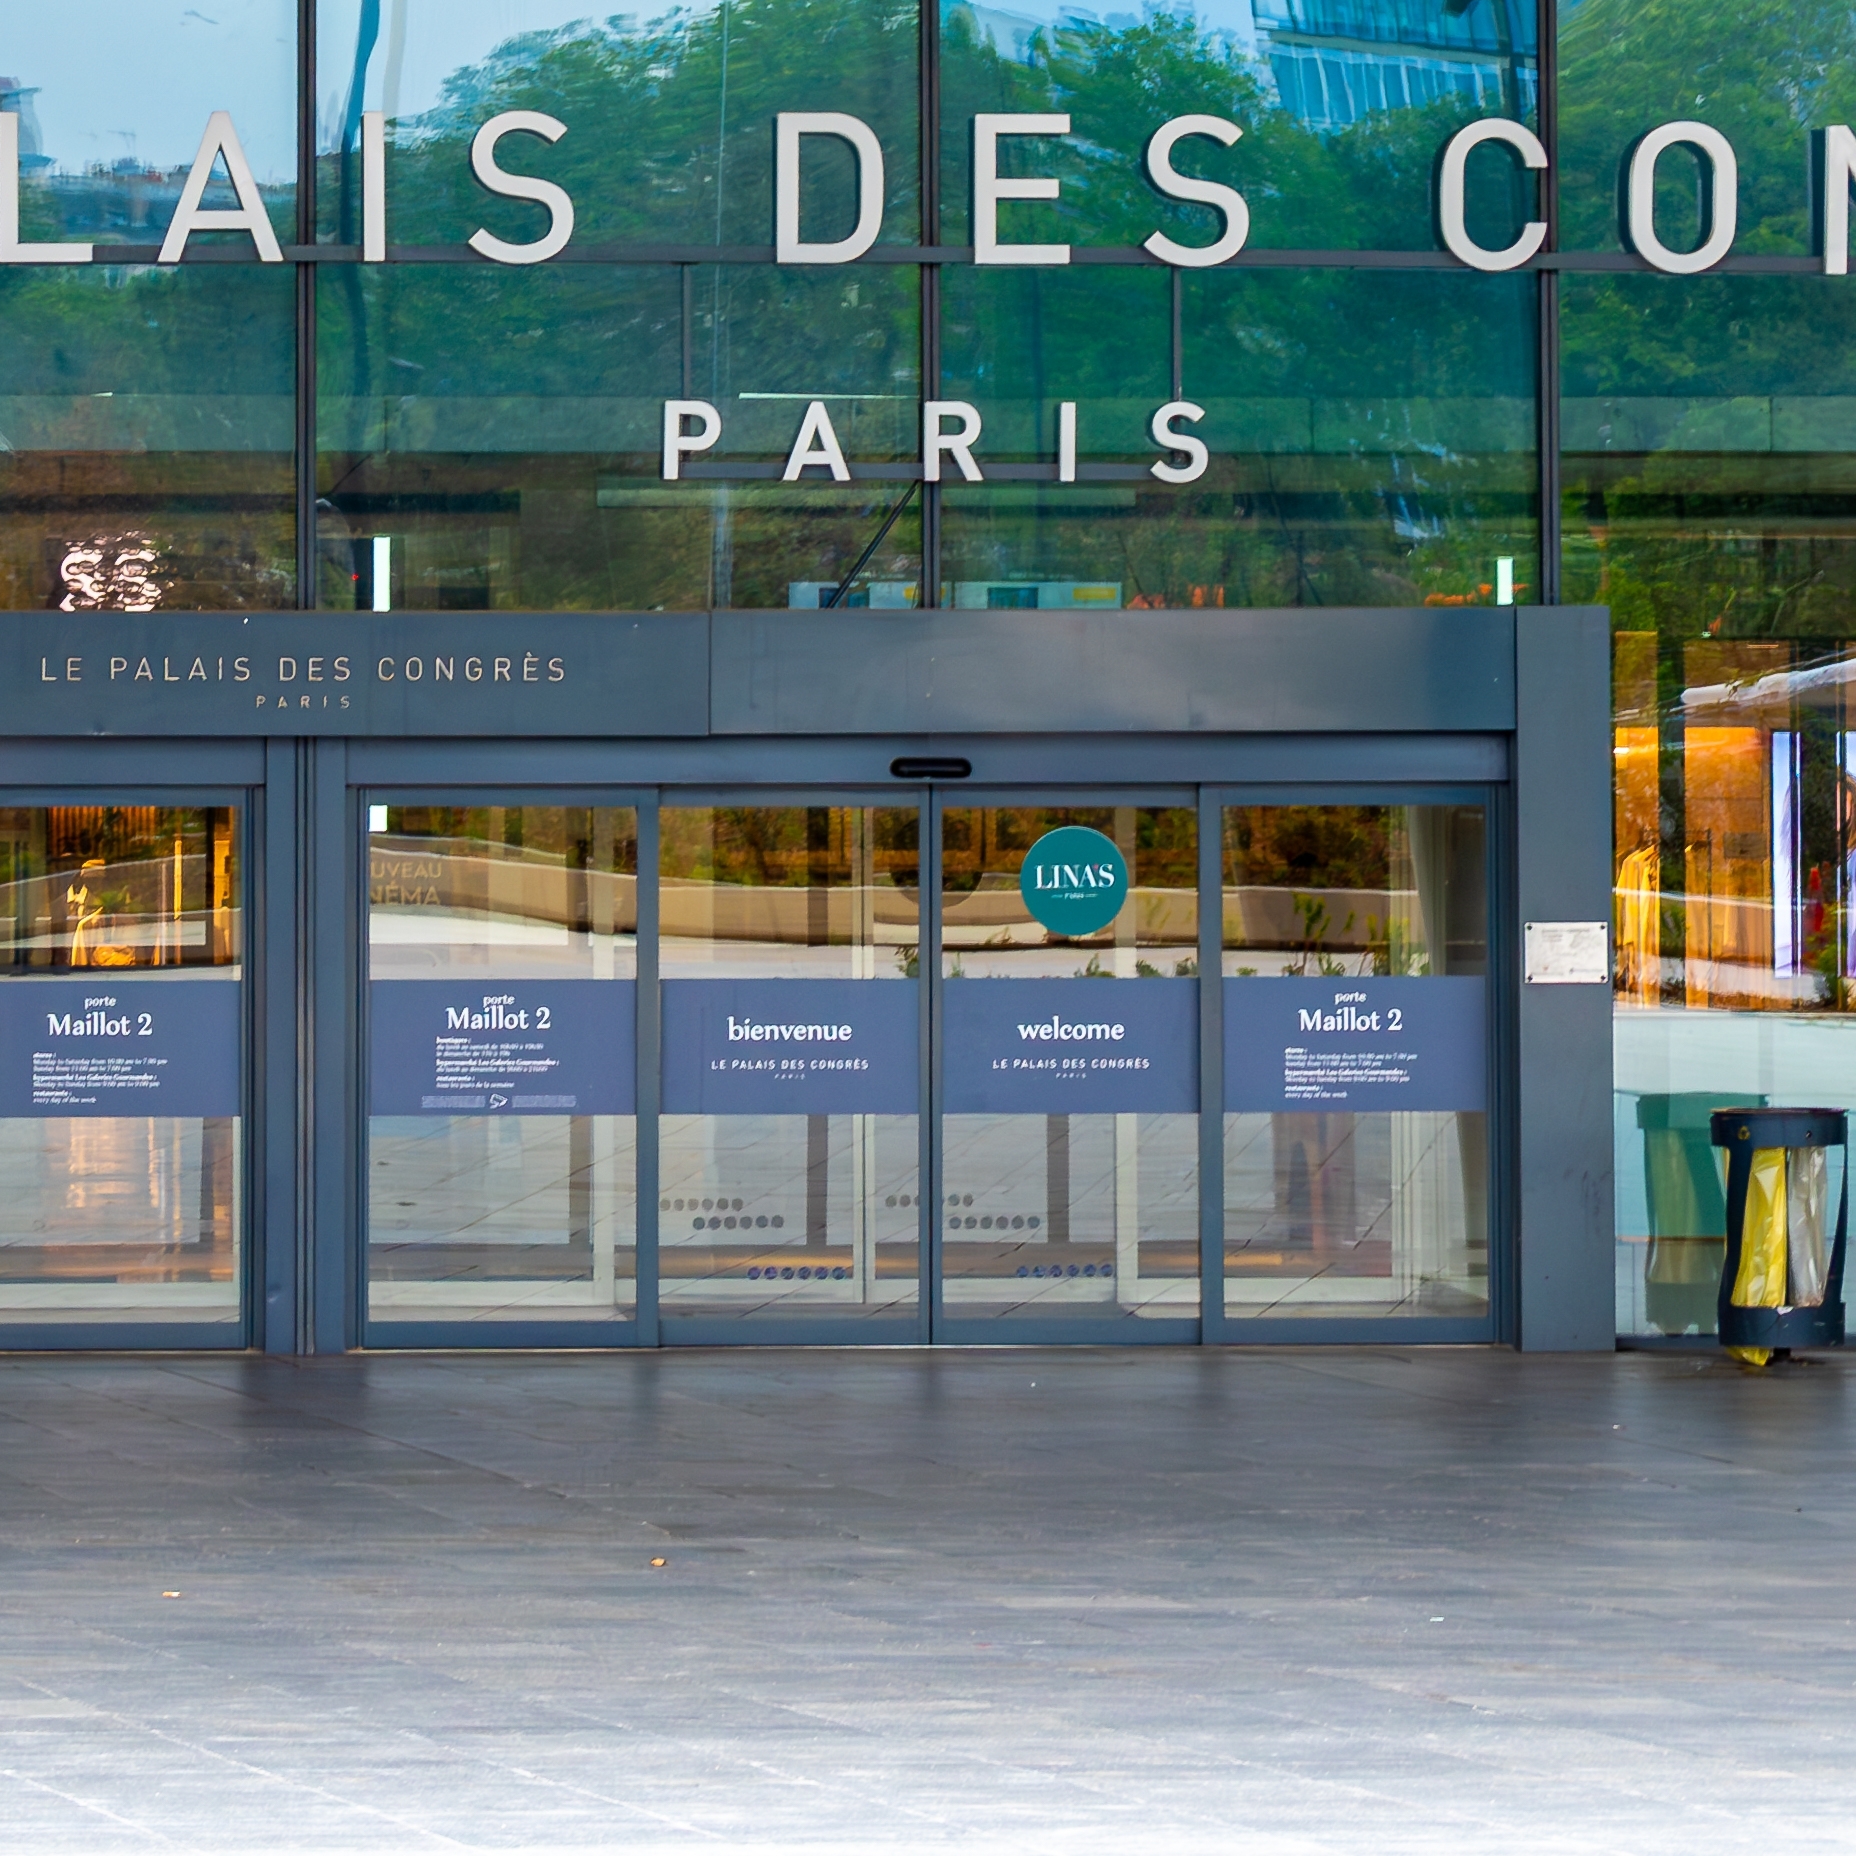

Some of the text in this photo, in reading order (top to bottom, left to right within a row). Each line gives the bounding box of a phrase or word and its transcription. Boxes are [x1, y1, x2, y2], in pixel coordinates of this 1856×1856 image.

[774, 113, 1253, 270] DES
[662, 400, 1210, 485] PARIS
[41, 650, 567, 682] LE PALAIS DES CONGRÈS
[255, 695, 352, 710] PARIS
[370, 861, 442, 878] UVEAU
[370, 880, 442, 905] NÉMA
[84, 995, 117, 1010] porte
[483, 994, 516, 1008] porte
[1334, 991, 1367, 1005] porte
[46, 1010, 153, 1036] Maillot 2
[445, 1005, 552, 1030] Maillot 2
[727, 1016, 853, 1042] bienvenue
[1017, 1015, 1126, 1041] welcome
[1298, 1007, 1403, 1032] Maillot 2
[711, 1059, 727, 1070] LE
[731, 1059, 777, 1070] PALAIS
[781, 1059, 806, 1070] DES
[992, 1058, 1008, 1070] LE
[1012, 1058, 1058, 1069] PALAIS
[1062, 1058, 1087, 1070] DES
